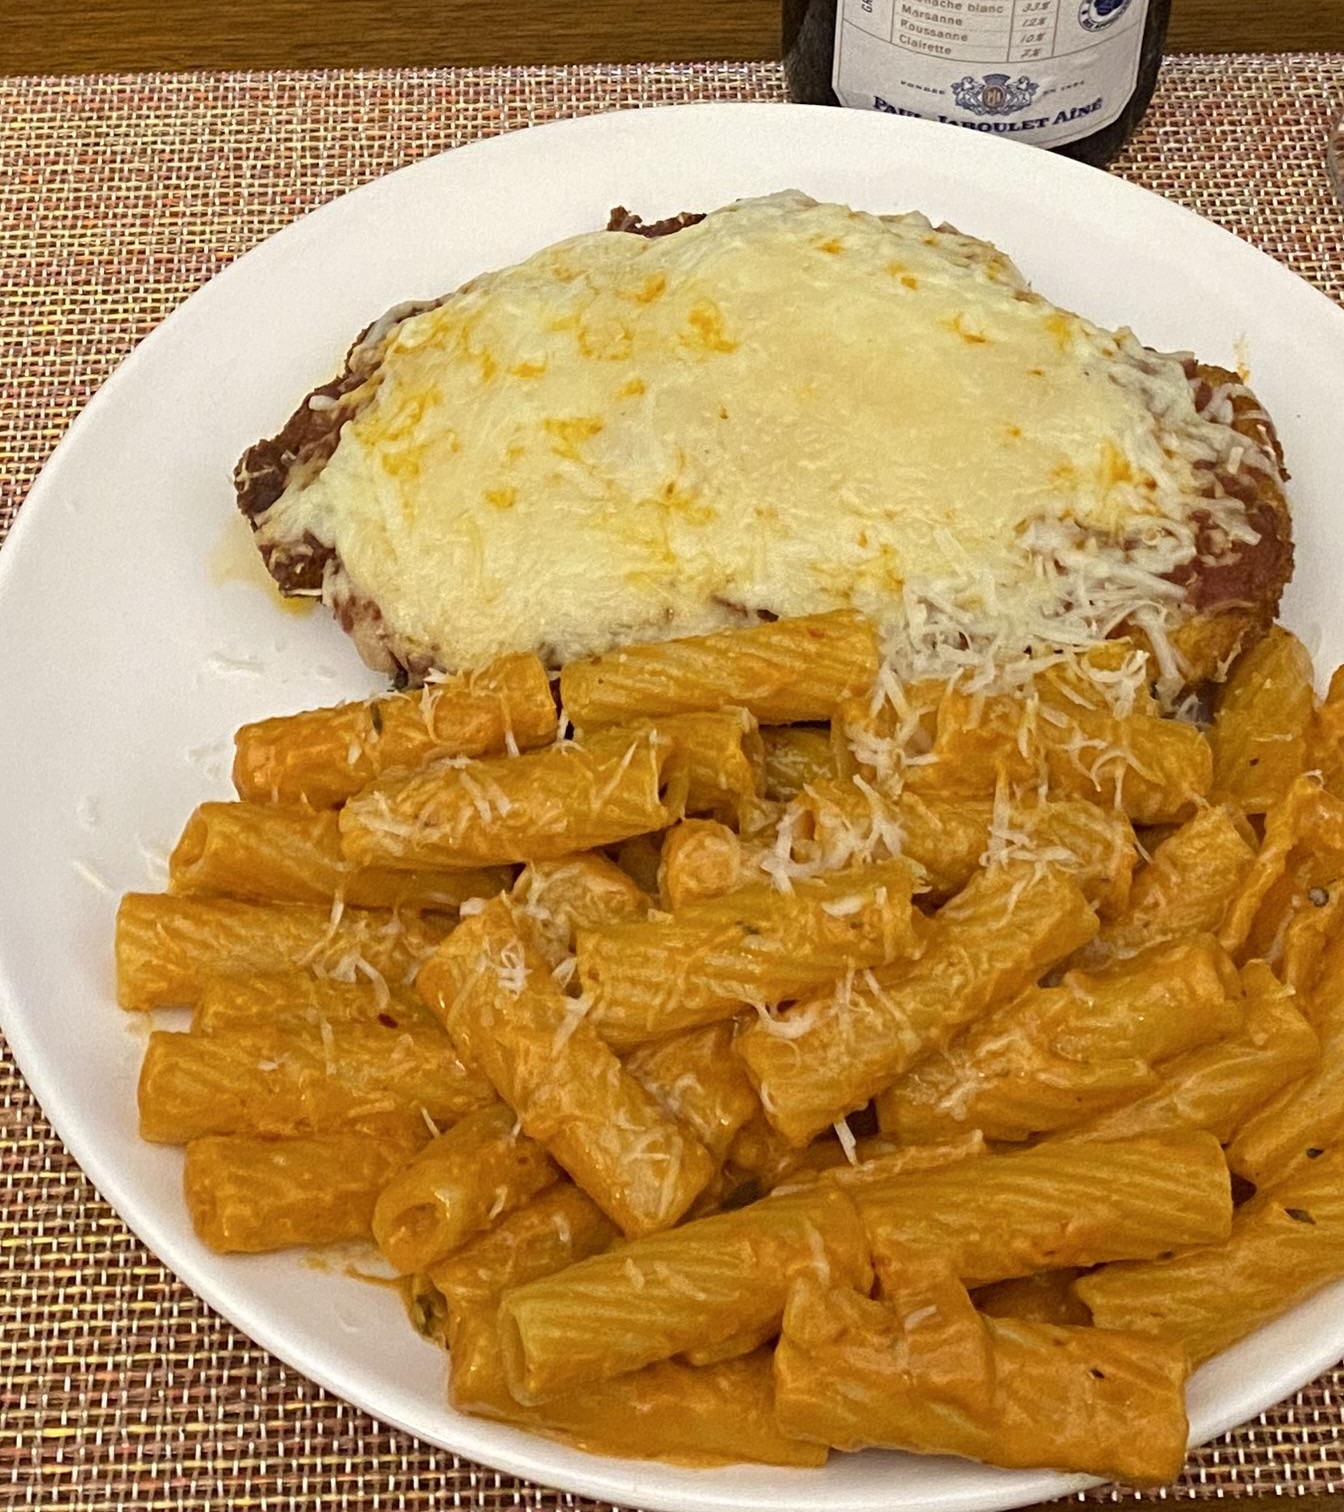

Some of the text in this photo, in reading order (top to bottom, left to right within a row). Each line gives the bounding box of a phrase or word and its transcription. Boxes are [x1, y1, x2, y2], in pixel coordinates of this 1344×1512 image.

[901, 4, 963, 26] Marsanne
[967, 1, 1004, 14] blanc
[900, 19, 969, 42] Roussanne
[899, 34, 952, 55] Clairette
